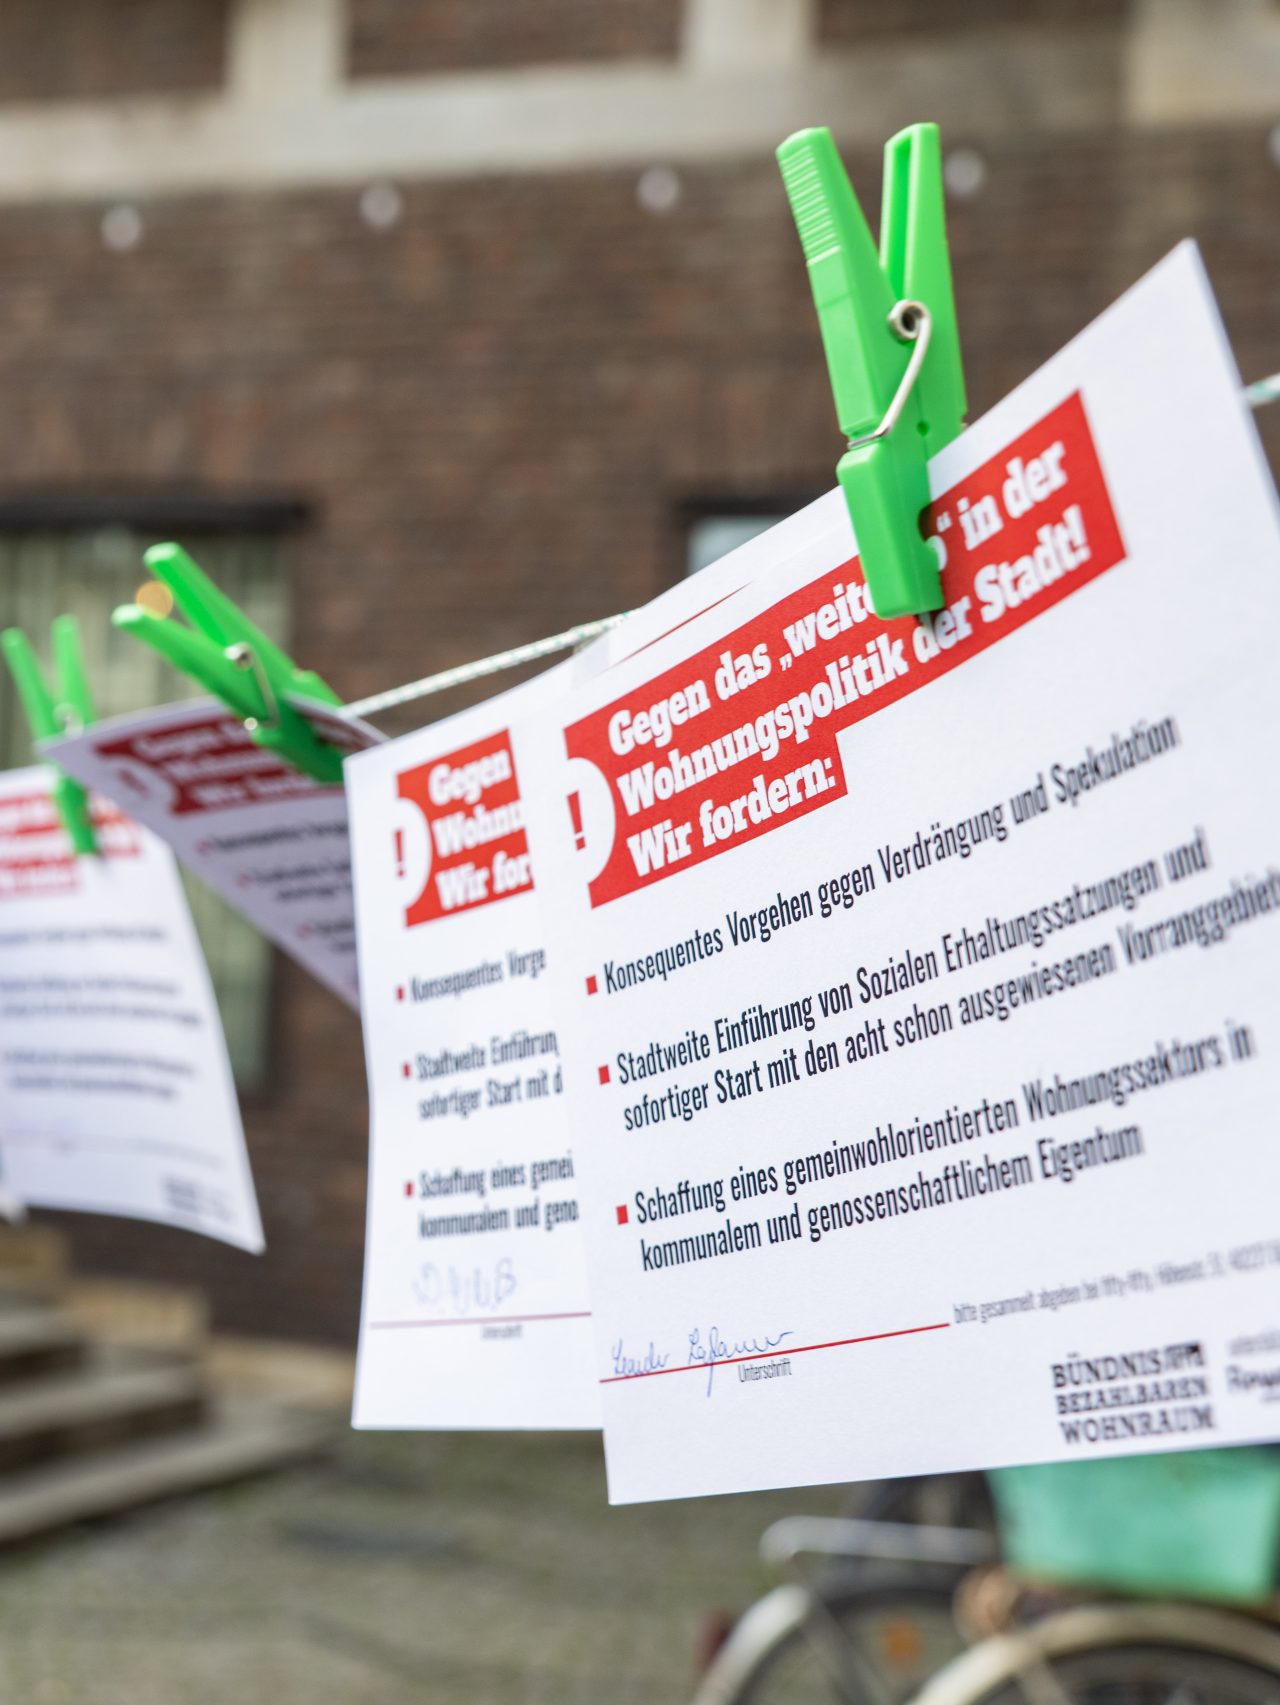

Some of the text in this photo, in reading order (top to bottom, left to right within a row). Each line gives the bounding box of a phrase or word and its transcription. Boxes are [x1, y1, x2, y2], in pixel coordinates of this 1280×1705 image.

[608, 679, 711, 756] Gegen
[715, 643, 771, 700] das
[957, 494, 1004, 551] in
[1002, 440, 1068, 519] der
[616, 633, 909, 816] Wohnungspolitik
[912, 596, 973, 663] der
[974, 504, 1091, 623] Stadt!
[428, 749, 512, 806] Gegen
[627, 757, 836, 877] Wir fordern:
[604, 715, 1180, 994] Konsequentes Vorgehen gegen Verdrängung und Spekulation
[435, 862, 489, 910] Wir
[410, 958, 504, 1002] Konsequentes
[617, 824, 1211, 1084] Stadtweite Einführung von Sozialen Erhaltungssatzungen und
[416, 1042, 485, 1081] Stadtweite
[624, 1081, 709, 1131] sofortiger
[714, 1060, 763, 1104] Start
[768, 1048, 800, 1088] mit
[805, 1039, 840, 1077] den
[845, 1018, 889, 1064] acht
[893, 1003, 953, 1047] schon
[959, 941, 1117, 1021] ausgewiesenen
[419, 1086, 481, 1120] sofortiger
[486, 1076, 522, 1107] Start
[526, 1068, 548, 1099] mit
[635, 1018, 1254, 1224] Schaffung eines gemeinwohlorientierten Wohnungssektors in
[420, 1166, 486, 1199] Schaffung
[490, 1159, 526, 1189] eines
[641, 1124, 1145, 1271] kommunalem und genossenschaftlichem Eigentum
[419, 1202, 509, 1239] kommunalem
[514, 1195, 540, 1228] und
[738, 1358, 792, 1382] Unterschrift
[1051, 1350, 1162, 1388] BÜNDNIS
[1055, 1376, 1208, 1415] BEZAHLBAREN
[1058, 1405, 1215, 1444] WOHNRAUM
